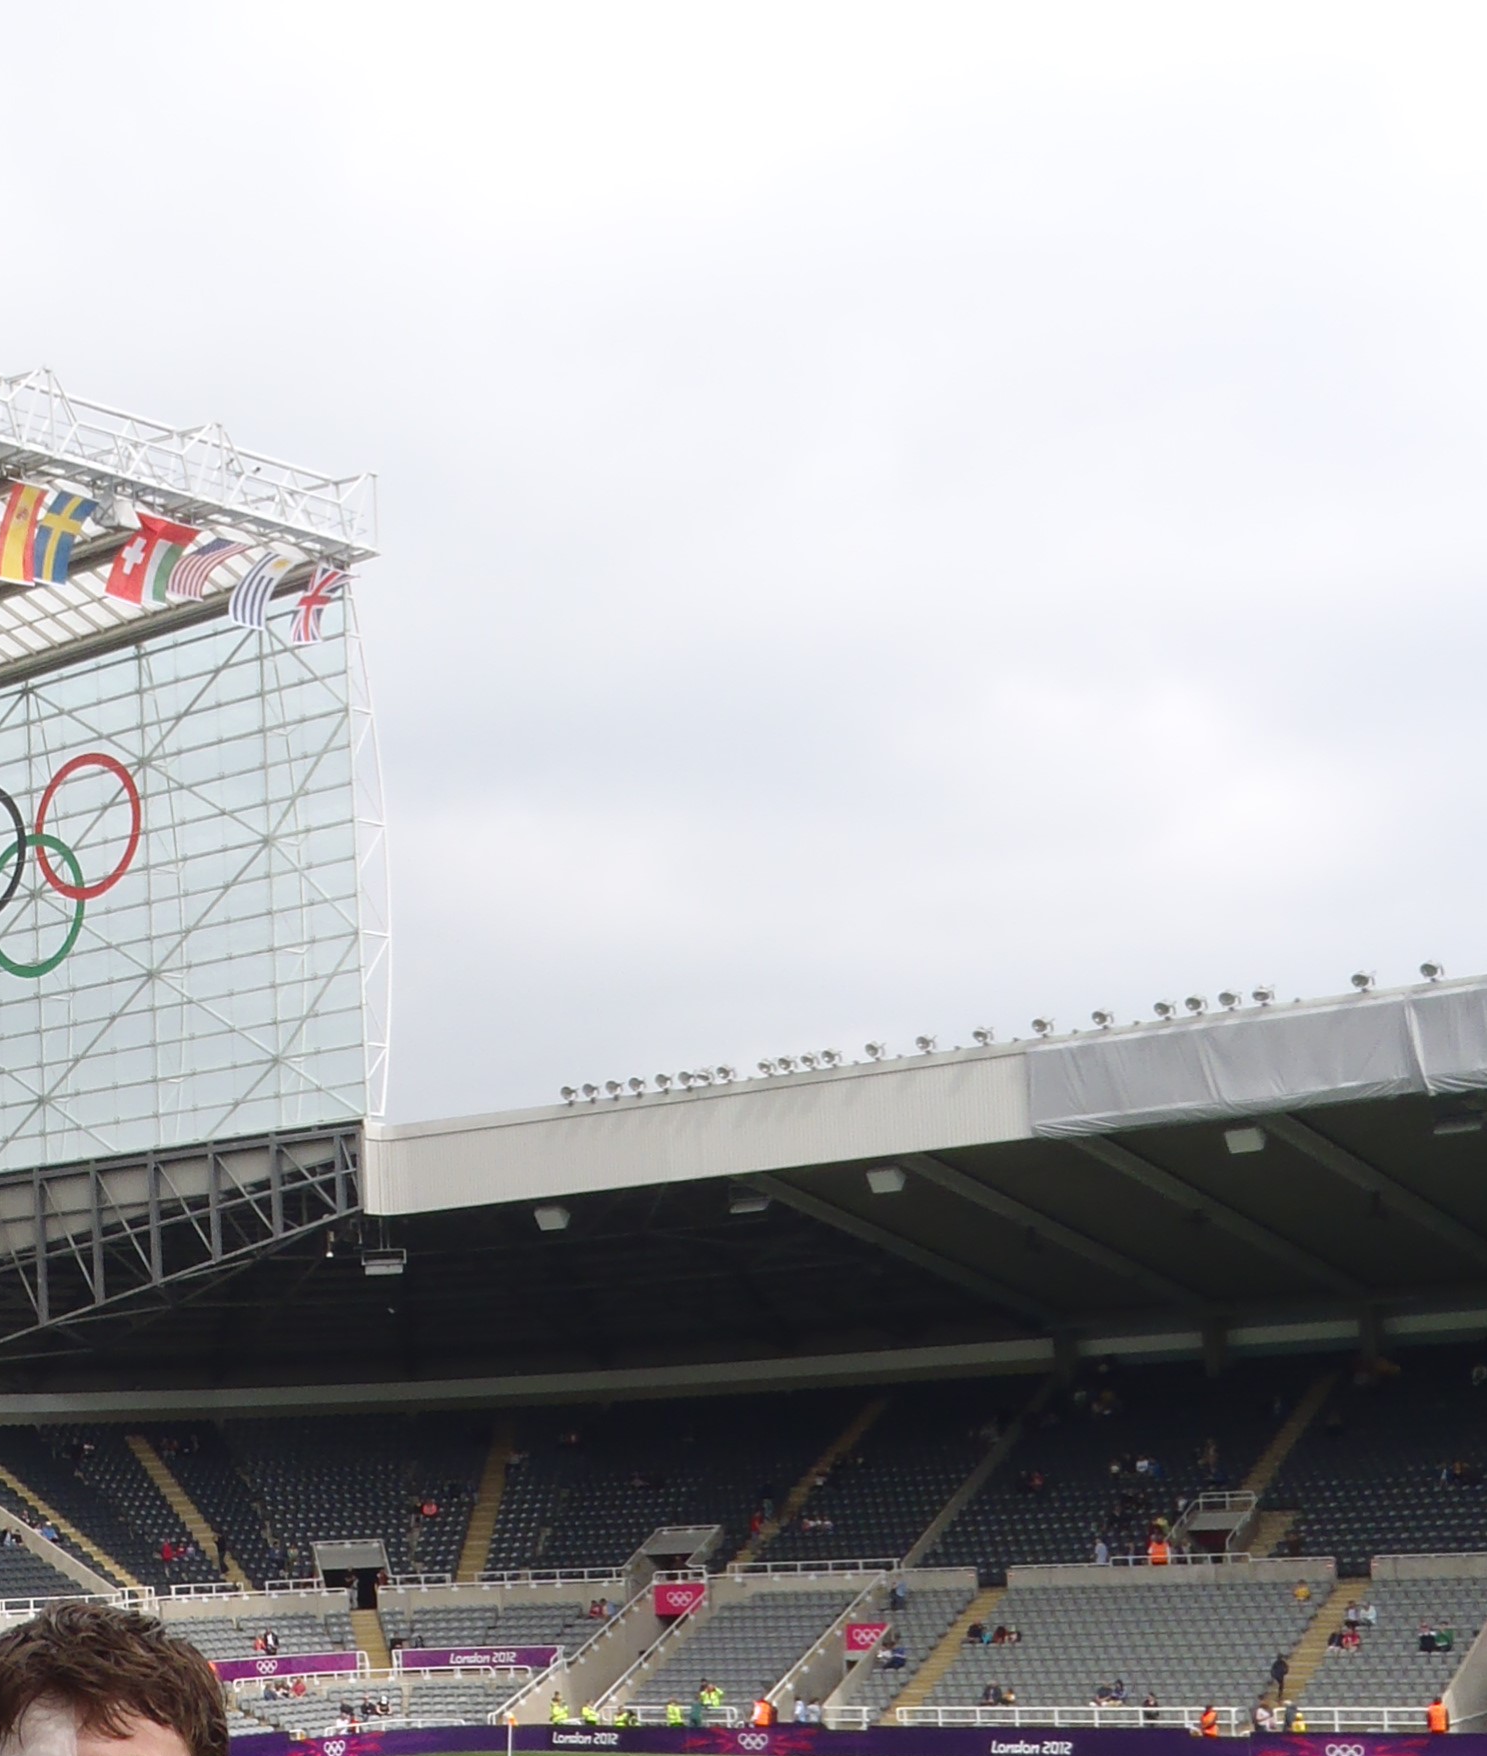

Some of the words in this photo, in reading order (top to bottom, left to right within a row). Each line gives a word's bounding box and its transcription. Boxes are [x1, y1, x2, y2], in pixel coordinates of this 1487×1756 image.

[450, 1652, 491, 1664] London
[492, 1651, 517, 1664] 2012
[552, 1731, 592, 1745] London
[593, 1732, 619, 1746] 2012
[991, 1739, 1040, 1754] London
[1041, 1741, 1073, 1755] 2012
